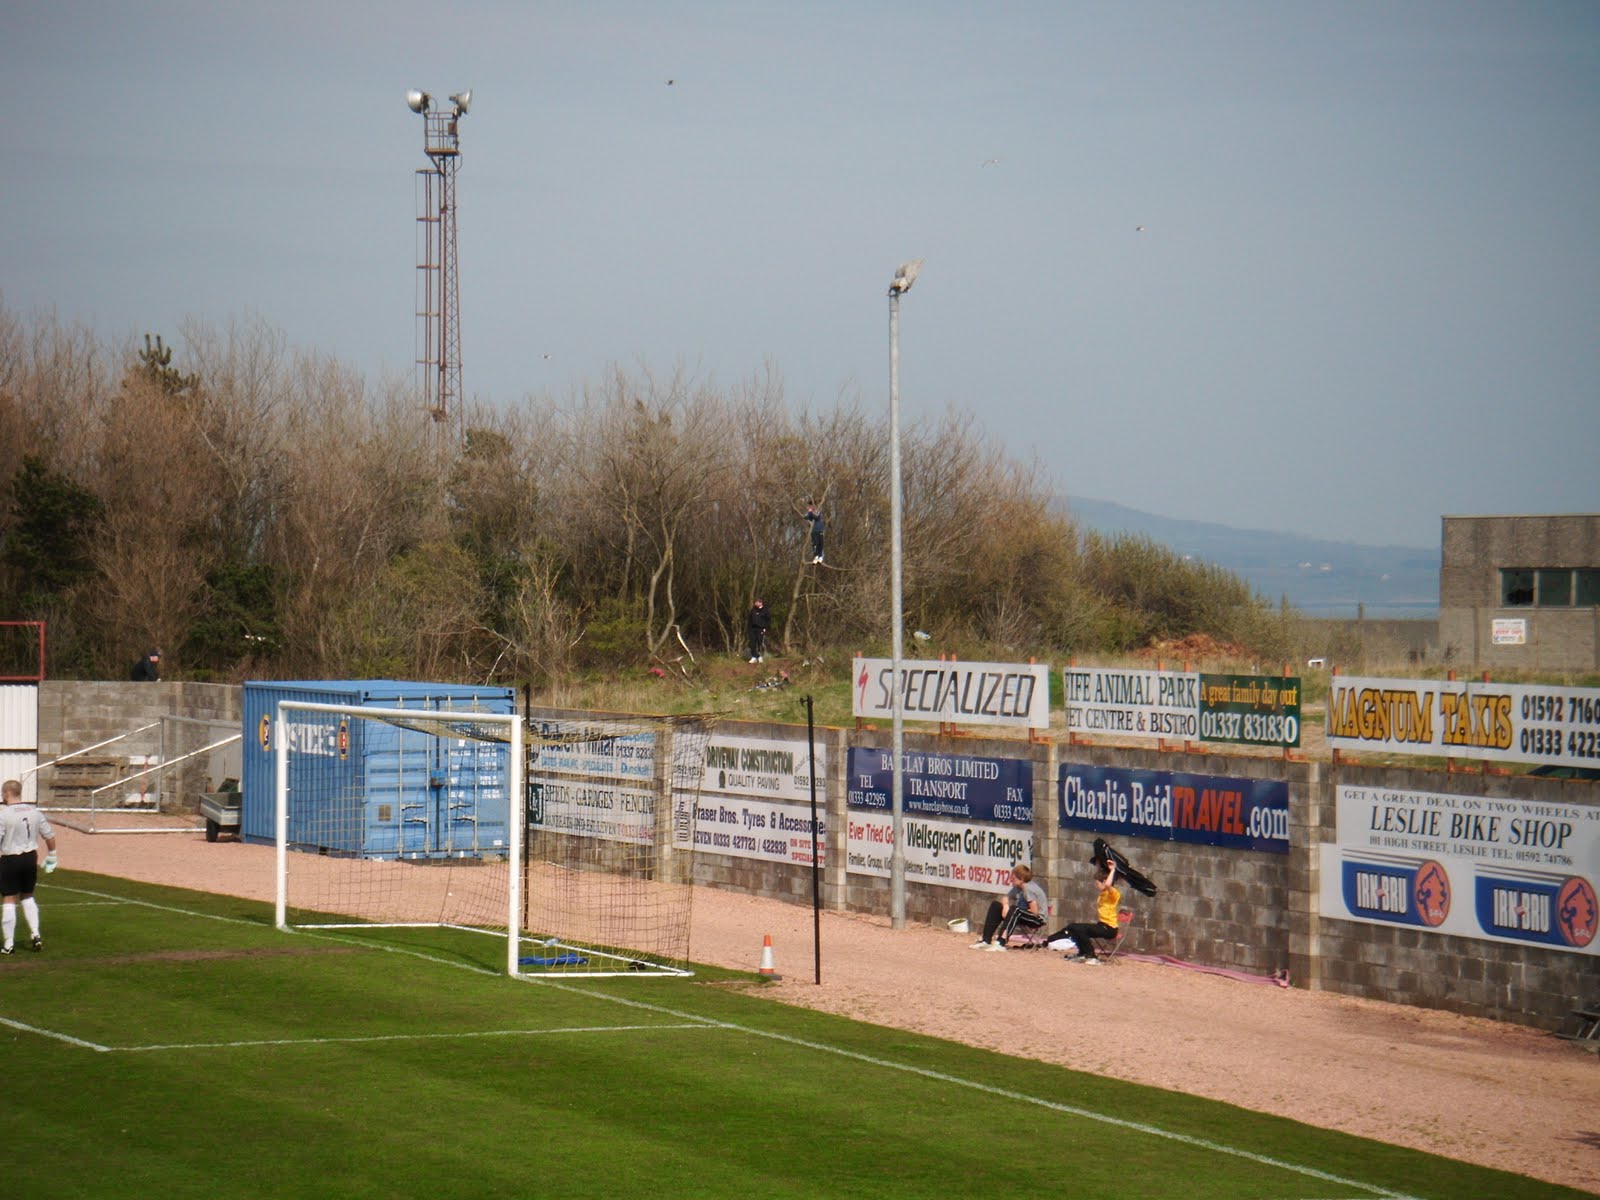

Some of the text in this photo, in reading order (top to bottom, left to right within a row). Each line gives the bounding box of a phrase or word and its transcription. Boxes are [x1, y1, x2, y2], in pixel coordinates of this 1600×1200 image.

[1094, 674, 1154, 705] ANIMAL
[1158, 676, 1196, 708] PARK
[1201, 680, 1297, 710] A great family day out
[1086, 708, 1134, 730] CENTRE
[1136, 711, 1146, 732] &
[1150, 712, 1196, 736] BISTRO
[1327, 686, 1512, 750] MAGNUM TAXIS
[1521, 695, 1563, 722] 01592
[1201, 711, 1297, 743] 01337 831830
[1520, 728, 1562, 755] 01333
[706, 746, 739, 770] DRIVEWAY
[741, 748, 793, 775] CONSTRUCTION
[881, 754, 999, 780] BACLAY BROS LIMITED
[729, 773, 755, 788] QUALITY
[757, 776, 780, 791] PAVING
[860, 775, 874, 789] TEL
[910, 778, 967, 800] TRANSPORT
[1007, 787, 1023, 802] FAX
[620, 793, 654, 815] FENCIN
[849, 790, 886, 807] 01333 422955
[994, 804, 1012, 820] 01333
[1064, 775, 1289, 840] Charlie Reid TRAVEL .com
[1344, 790, 1366, 801] GET
[1371, 793, 1379, 801] A
[1383, 792, 1421, 805] GREAT
[1427, 797, 1459, 808] DEAL
[1463, 800, 1481, 809] ON
[1487, 802, 1517, 813] TWO
[1522, 805, 1580, 819] WHEELS
[693, 803, 826, 834] Fraser Bros. Tyres & Accessoie
[1370, 805, 1572, 849] LESLIE BIKE SHOP
[693, 830, 711, 845] LEVEN
[713, 832, 730, 848] 01333
[733, 835, 756, 851] 427723
[762, 839, 787, 855] 422938
[849, 822, 864, 840] Ever
[866, 823, 883, 843] Tried
[907, 822, 1023, 867] Wellsgreen Golf Range
[1384, 837, 1408, 848] HIGH
[1411, 840, 1451, 854] STREET,
[1453, 843, 1488, 857] LESLIE
[1491, 848, 1513, 860] TEL:
[1516, 851, 1540, 863] 01592
[1544, 853, 1573, 866] 741786
[925, 862, 938, 876] From
[951, 863, 966, 880] Tel:
[969, 865, 992, 884] 01592
